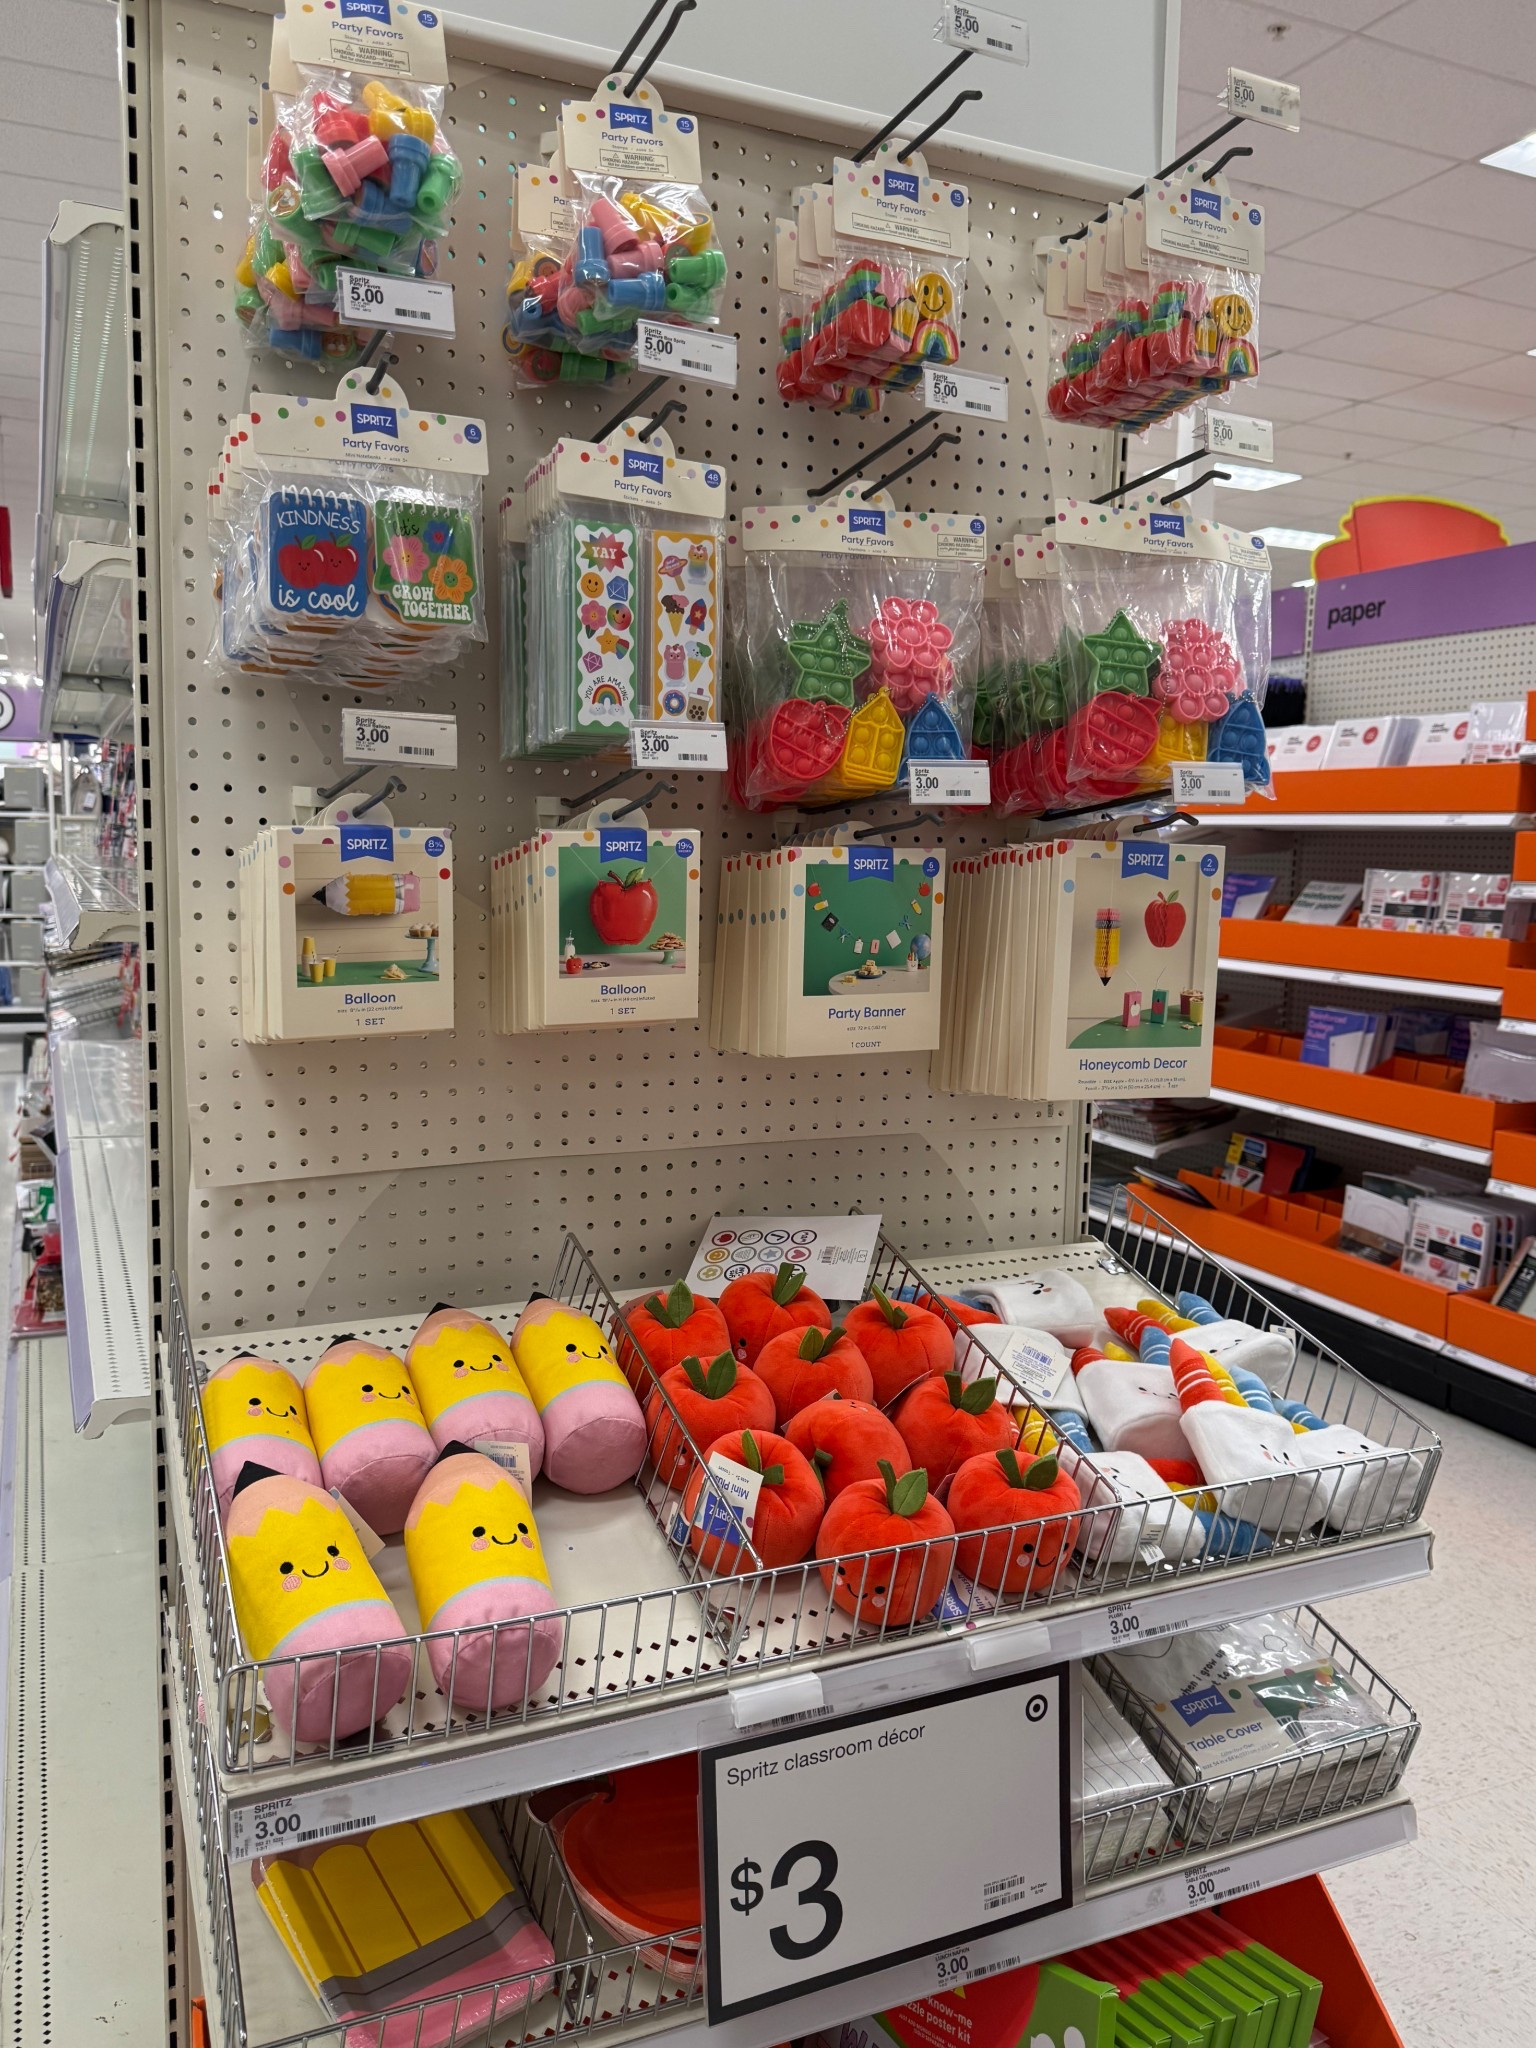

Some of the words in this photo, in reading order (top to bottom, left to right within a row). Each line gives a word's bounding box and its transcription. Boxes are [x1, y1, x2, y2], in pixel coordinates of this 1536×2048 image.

[422, 13, 433, 22] 15
[955, 15, 979, 33] 5.00
[332, 21, 363, 36] Party
[366, 26, 404, 40] Favors
[358, 46, 395, 58] WARNING:
[1234, 87, 1255, 102] 5.00
[601, 132, 628, 145] Party
[630, 135, 664, 147] Favors
[624, 153, 655, 163] WARNING:
[954, 192, 961, 200] 15
[876, 199, 898, 212] Party
[900, 203, 927, 217] Favors
[1252, 211, 1259, 220] 15
[894, 223, 920, 234] WARNING:
[1183, 216, 1203, 229] Party
[1204, 220, 1228, 234] Favors
[349, 275, 370, 284] Spritz
[351, 286, 384, 304] 5.00
[644, 326, 662, 335] Spritz
[645, 336, 673, 354] 5.00
[934, 382, 958, 398] 5.00
[470, 428, 476, 437] 6
[1213, 427, 1233, 440] 5.00
[342, 437, 372, 451] Party
[375, 440, 410, 454] Favors
[707, 473, 719, 482] 48
[614, 480, 639, 493] Party
[641, 484, 672, 498] Favors
[277, 509, 361, 534] KINDNESS
[393, 518, 419, 536] let's
[841, 535, 865, 547] Party
[866, 536, 894, 547] Favors
[1143, 536, 1165, 547] Party
[1167, 538, 1194, 549] Favors
[591, 546, 618, 560] YAY
[278, 585, 300, 607] is
[308, 584, 359, 612] cool
[392, 584, 434, 601] GROW
[402, 601, 472, 621] TOGETHER
[1327, 600, 1386, 630] paper
[585, 685, 594, 700] YOU
[592, 675, 606, 686] ARE
[607, 676, 629, 702] AMAZING
[355, 716, 377, 725] Spritz
[356, 727, 390, 743] 3.00
[640, 728, 658, 736] Spritz
[641, 739, 670, 752] 3.00
[916, 777, 938, 789] 3.00
[1181, 778, 1202, 789] 3.00
[1207, 858, 1212, 867] 2
[600, 984, 646, 995] Balloon
[345, 992, 396, 1005] Balloon
[618, 1007, 636, 1015] SET
[828, 1008, 861, 1021] Party
[864, 1007, 906, 1018] Banner
[365, 1017, 385, 1026] SET
[1079, 1058, 1150, 1073] Honeycomb
[1153, 1057, 1188, 1069] Decor
[714, 1475, 730, 1491] Plus
[731, 1485, 750, 1499] Mini
[1107, 1602, 1132, 1614] SPRITZ
[1110, 1615, 1139, 1635] 3.00
[1201, 1658, 1217, 1677] grow
[1187, 1731, 1225, 1752] Table
[1226, 1721, 1264, 1739] Cover
[727, 1758, 779, 1786] Spritz
[784, 1737, 873, 1772] classroom
[878, 1723, 926, 1748] décor
[254, 1798, 292, 1814] SPRITZ
[254, 1811, 277, 1820] PLUSH
[255, 1814, 301, 1839] 3.00
[1185, 1866, 1207, 1879] SPRITZ
[1188, 1879, 1215, 1899] 3.00
[730, 1839, 844, 1961] $3
[936, 1951, 952, 1962] LUNCH
[952, 1947, 970, 1957] NAPKIN
[937, 1955, 968, 1978] 3.00
[926, 2011, 956, 2037] poster
[957, 2027, 971, 2046] kit
